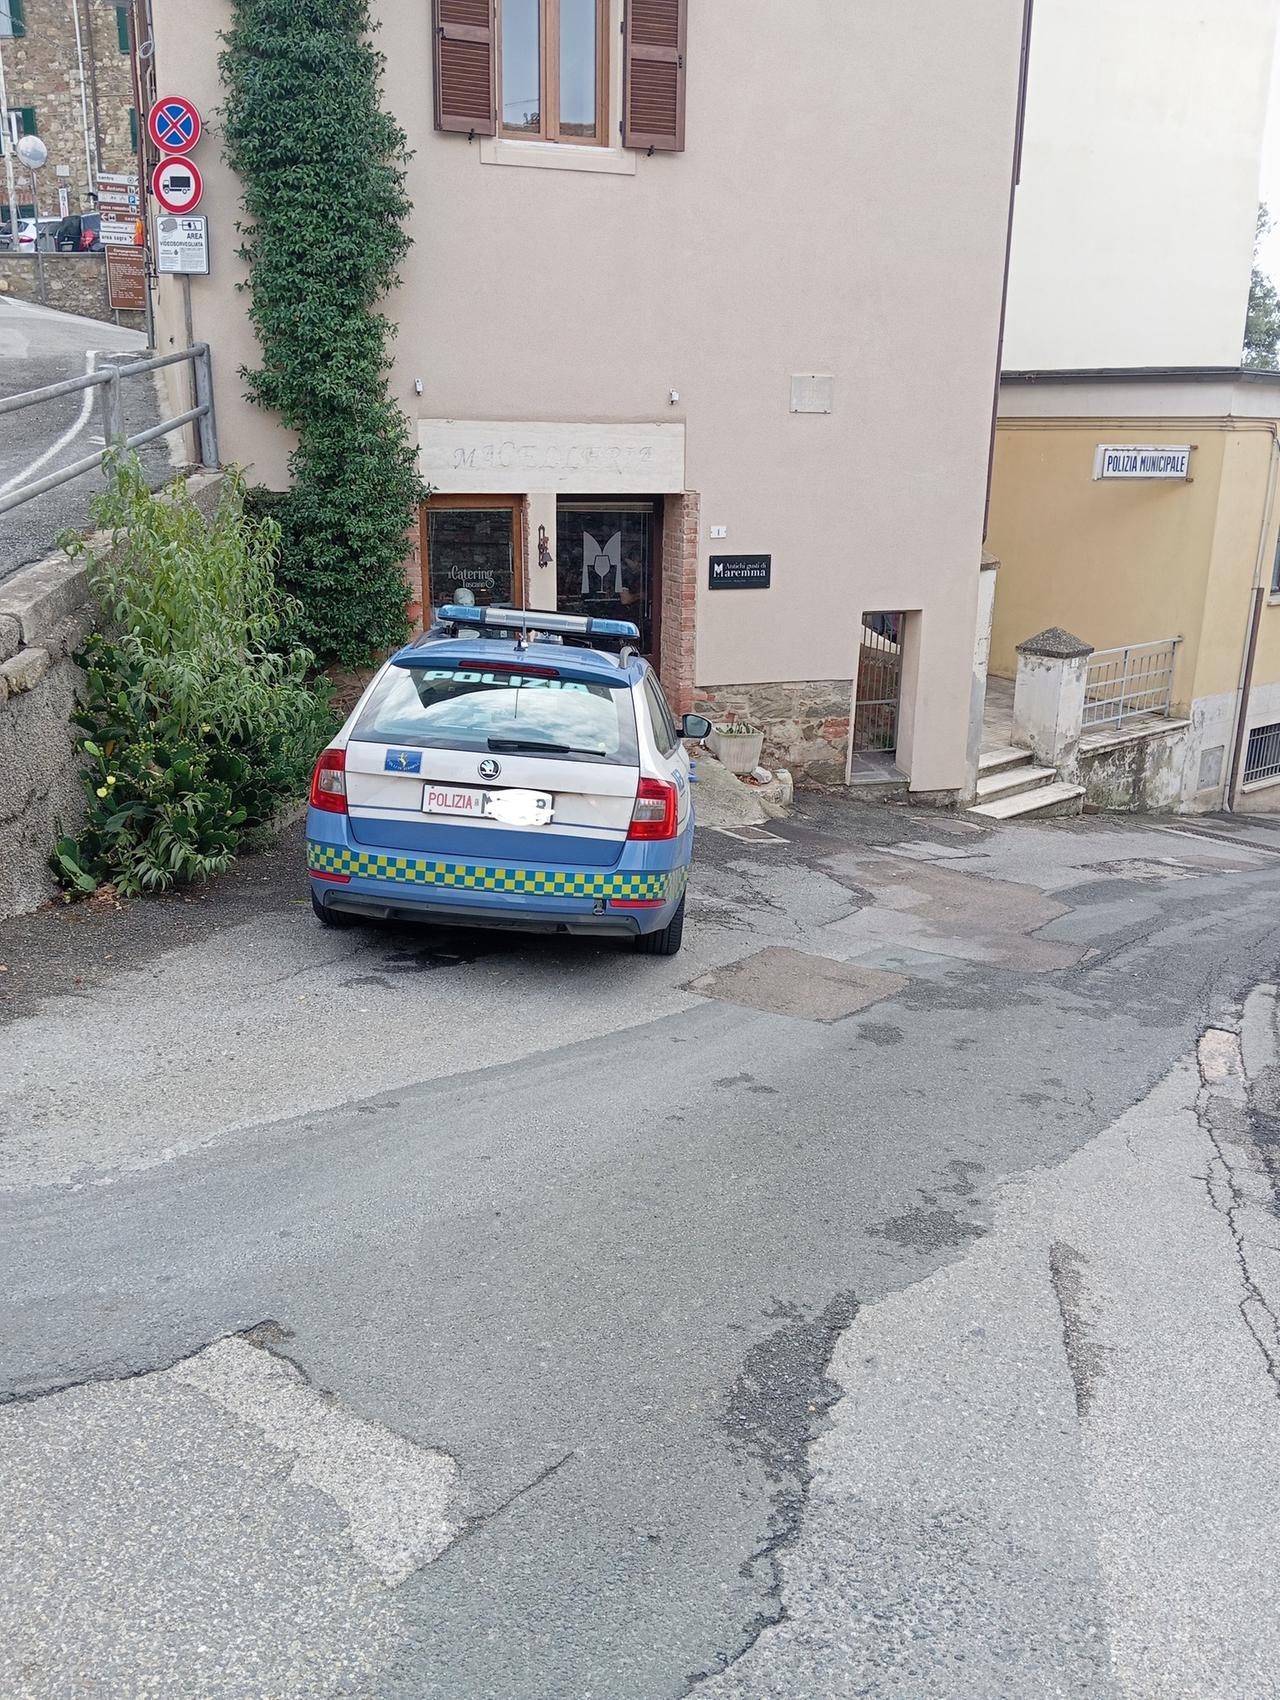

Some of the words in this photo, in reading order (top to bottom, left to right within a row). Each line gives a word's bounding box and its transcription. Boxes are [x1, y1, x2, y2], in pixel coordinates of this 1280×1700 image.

[1106, 455, 1138, 472] POLIZIA
[1139, 455, 1186, 473] MUNICIPALE
[451, 565, 495, 589] Catering
[713, 563, 766, 578] Maremma
[423, 670, 590, 693] POLIZIA
[428, 792, 473, 810] POLIZIA
